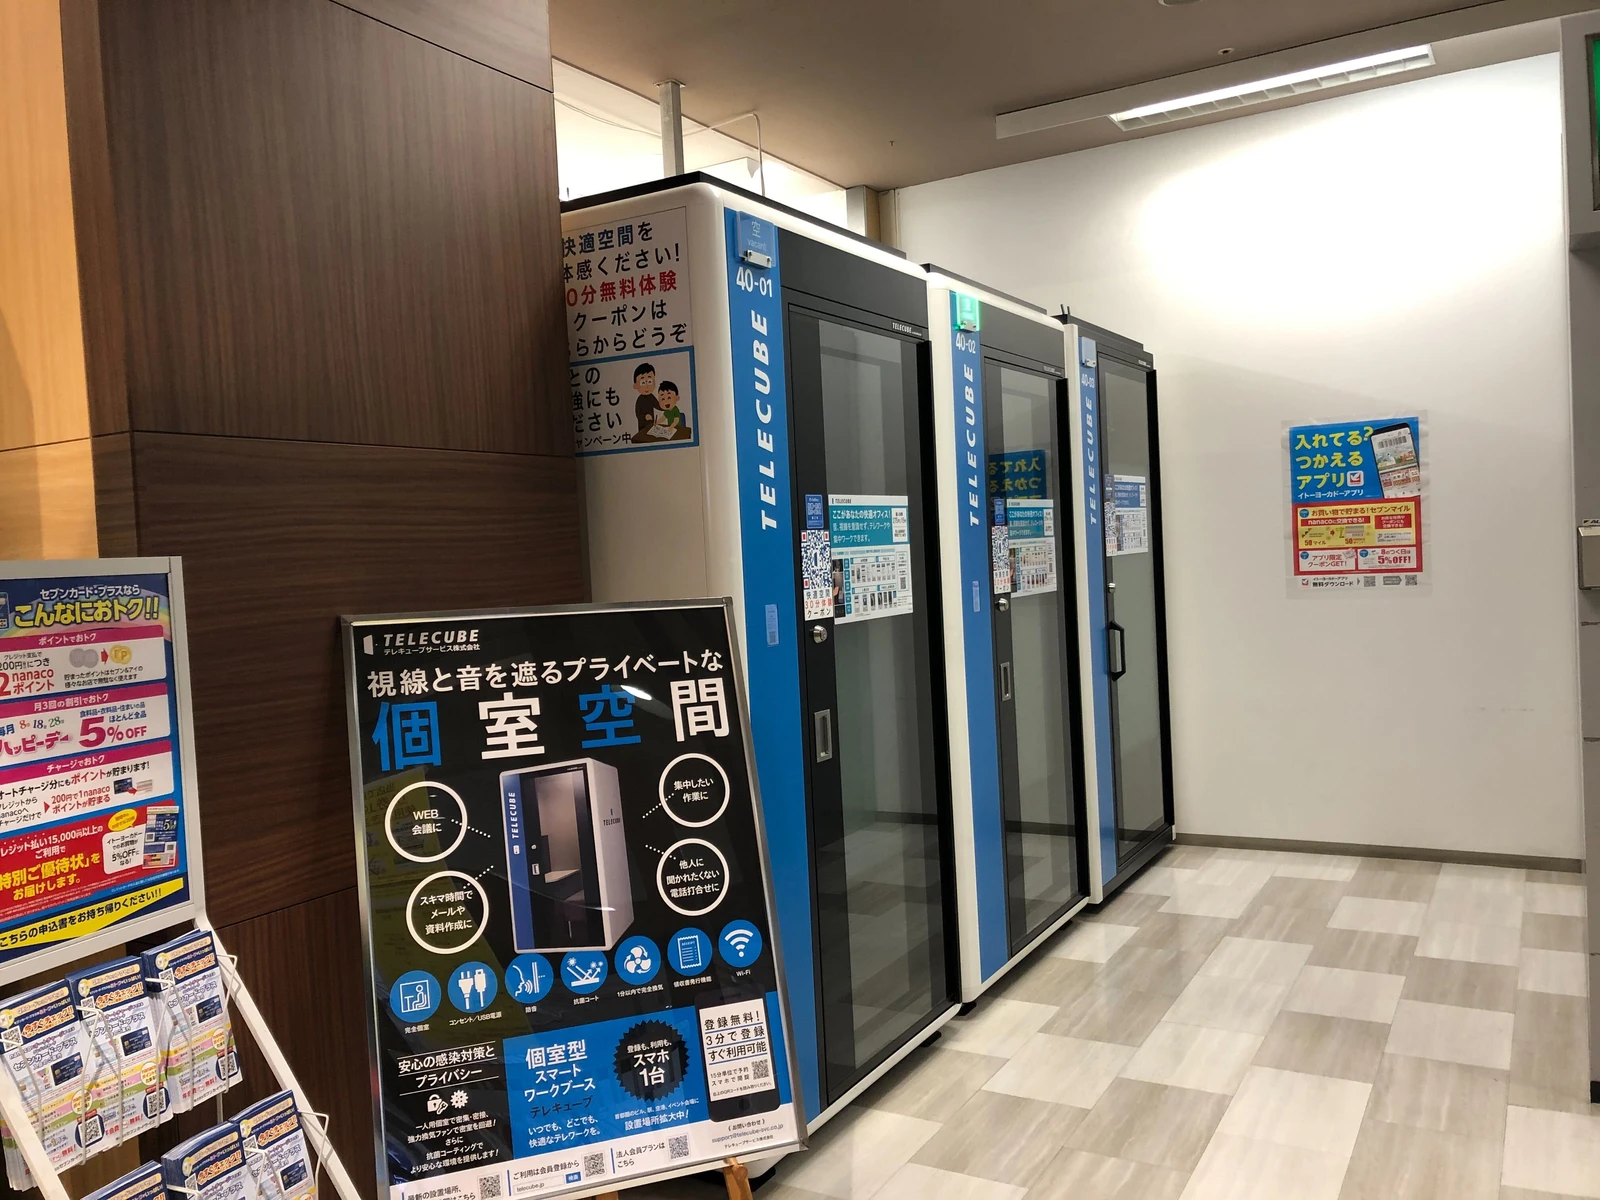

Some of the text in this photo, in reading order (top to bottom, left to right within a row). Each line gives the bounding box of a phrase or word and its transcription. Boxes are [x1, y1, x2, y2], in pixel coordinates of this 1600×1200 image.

[736, 266, 773, 298] 40-01
[573, 300, 667, 332] クーポンは
[568, 323, 687, 357] らからどうぞ
[955, 332, 976, 354] 40-02
[1081, 373, 1095, 389] 40-03
[751, 309, 778, 530] TELECUBE
[964, 363, 980, 527] TELECUBE
[1295, 426, 1374, 450] 入れてる?
[1084, 396, 1097, 525] TELECUBE
[1295, 451, 1363, 469] つかえる
[1297, 472, 1345, 489] アプリ
[1298, 490, 1364, 499] イトーヨーカドーアプリ
[1378, 556, 1411, 564] 5%OFF!
[40, 584, 140, 600] セブンカード・プラスなら
[1312, 580, 1354, 588] 無料ダウンロード
[14, 596, 159, 628] こんなにおトク!!
[807, 608, 831, 619] クーポン
[38, 633, 97, 646] ポイントでおトク
[383, 629, 480, 647] TELECUBE
[383, 643, 481, 656] テレキューブサービス株式会社
[12, 669, 54, 683] nanaco
[367, 649, 724, 698] 視線と音を遮るプライベートな
[0, 672, 12, 696] 2
[13, 679, 55, 695] ポイント
[34, 693, 109, 712] 月3回の割引でおトク
[109, 711, 147, 722] ほとんど全品
[47, 755, 105, 773] チャージでおトク
[673, 778, 714, 791] 集中したい
[52, 795, 111, 814] ポイントが貯まる
[682, 790, 709, 802] 作業に
[413, 809, 439, 820] WEB
[508, 792, 520, 839] TELECUBE
[411, 822, 442, 836] 会議に
[35, 845, 66, 859] ご利用で
[678, 857, 705, 870] 他人に
[13, 873, 82, 900] お届けします。
[666, 869, 720, 886] 聞かれたくない
[420, 890, 473, 907] スキマ時間で
[669, 883, 720, 899] 電話打合せに
[0, 888, 162, 947] こちらの申込書をお持ち帰りください!!
[430, 905, 466, 920] メールや
[424, 919, 473, 936] 資料作成に
[704, 1011, 760, 1031] 登録無料!
[706, 1026, 766, 1046] 3分で登録
[525, 1039, 588, 1070] 個室型
[627, 1039, 673, 1054] 登録も、利用も、
[708, 1041, 767, 1062] すぐ利用可能
[398, 1046, 496, 1074] 安心の感染対策と
[633, 1049, 671, 1068] スマホ
[415, 1069, 482, 1089] プライバシー
[535, 1064, 582, 1084] スマート
[639, 1067, 666, 1087] 1台
[524, 1077, 596, 1103] ワークブース
[530, 1095, 594, 1119] テレキューブ
[528, 1115, 599, 1135] いつでも、どこでも、
[625, 1109, 689, 1131] 設置場所拡大中!
[445, 1136, 464, 1146] さらに
[529, 1130, 601, 1149] 快適なテレワークを。
[426, 1141, 484, 1161] 抗菌コーティングで
[616, 1142, 665, 1158] 法人会員プランは
[410, 1149, 499, 1175] より安心な環境を提供します!
[513, 1160, 580, 1181] ご利用は会員登録から
[617, 1159, 634, 1168] こちら
